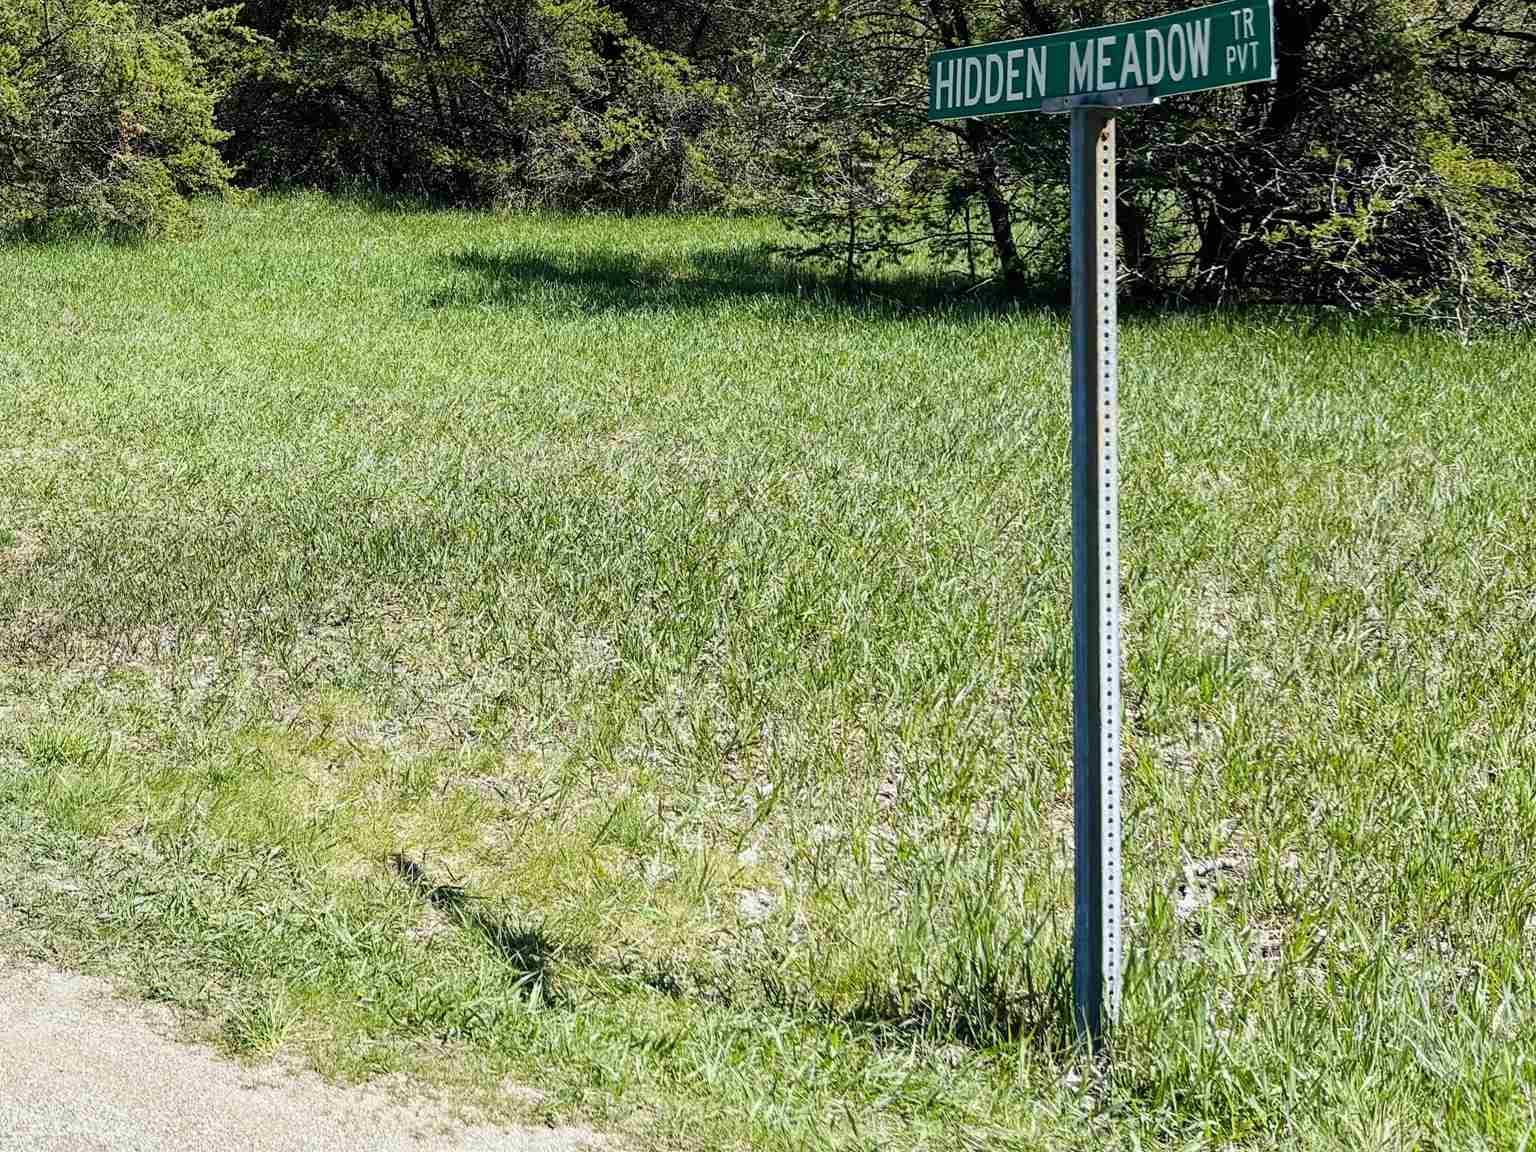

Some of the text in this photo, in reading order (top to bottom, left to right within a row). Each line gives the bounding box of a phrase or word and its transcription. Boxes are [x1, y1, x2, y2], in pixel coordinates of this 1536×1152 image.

[1230, 7, 1255, 41] TR
[935, 19, 1211, 110] HIDDEN MEADOW
[1225, 41, 1260, 76] PVT
